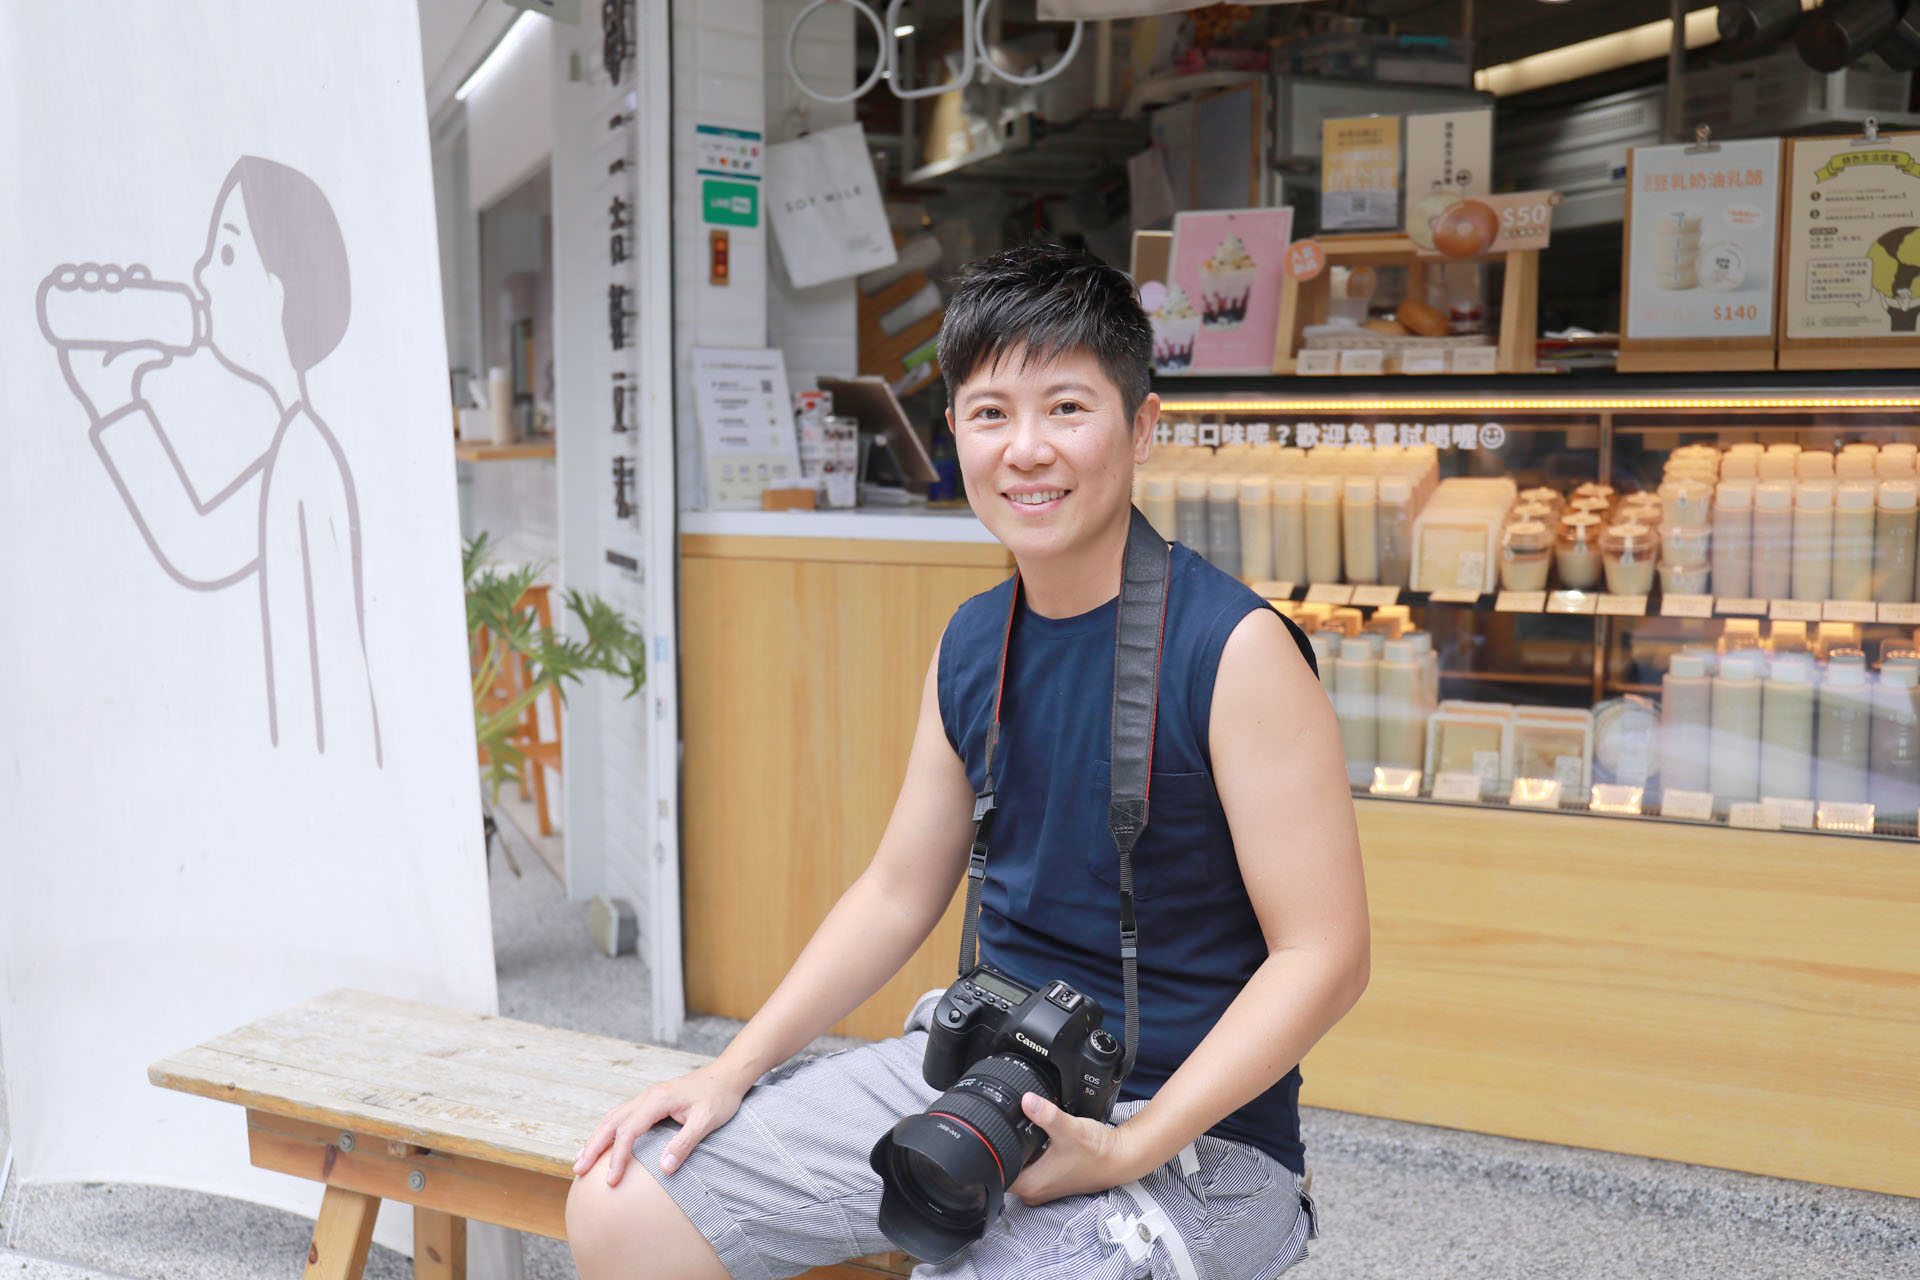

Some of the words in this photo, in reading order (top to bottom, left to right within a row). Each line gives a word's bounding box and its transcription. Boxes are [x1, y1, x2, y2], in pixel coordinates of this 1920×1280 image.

[1502, 203, 1547, 228] $50
[1713, 304, 1759, 321] $140
[1015, 1032, 1049, 1057] Canon
[1084, 1073, 1101, 1085] EOS
[1084, 1086, 1096, 1097] 5D
